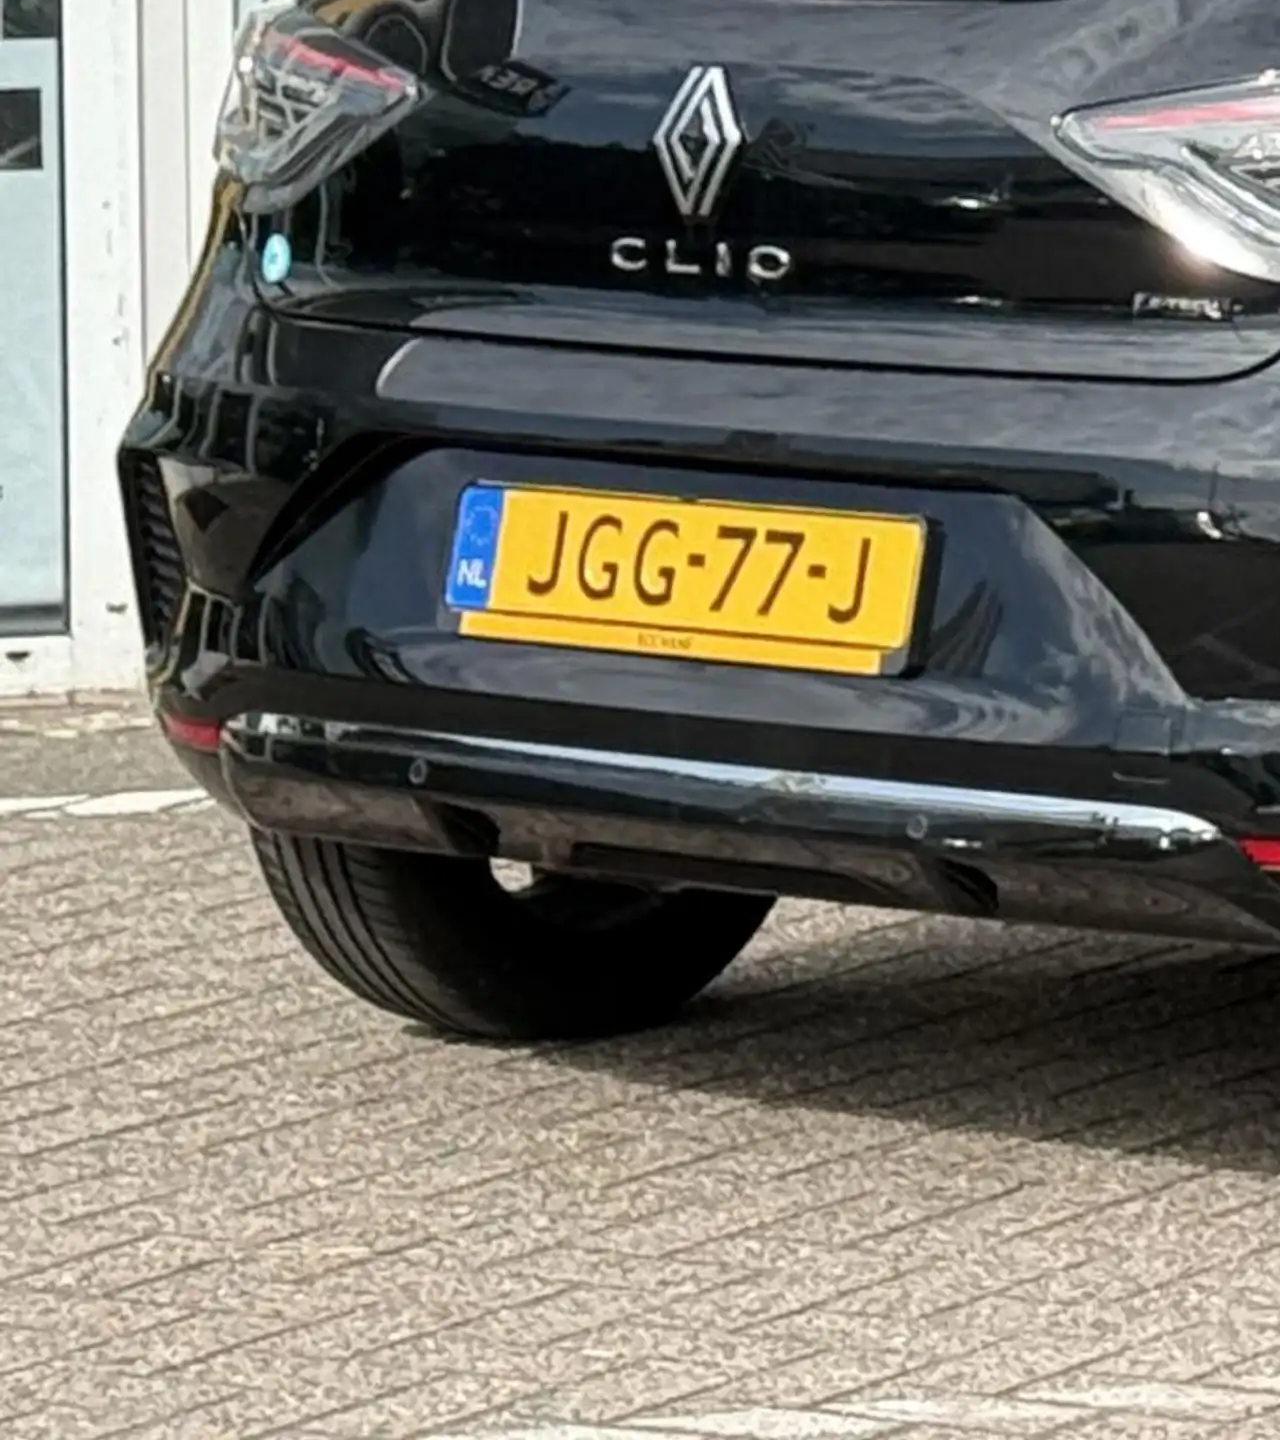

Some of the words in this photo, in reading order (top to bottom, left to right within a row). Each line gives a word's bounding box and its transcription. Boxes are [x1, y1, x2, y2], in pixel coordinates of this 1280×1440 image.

[611, 237, 791, 280] CLIO
[457, 558, 487, 588] NL
[526, 511, 872, 624] JGG-77-J
